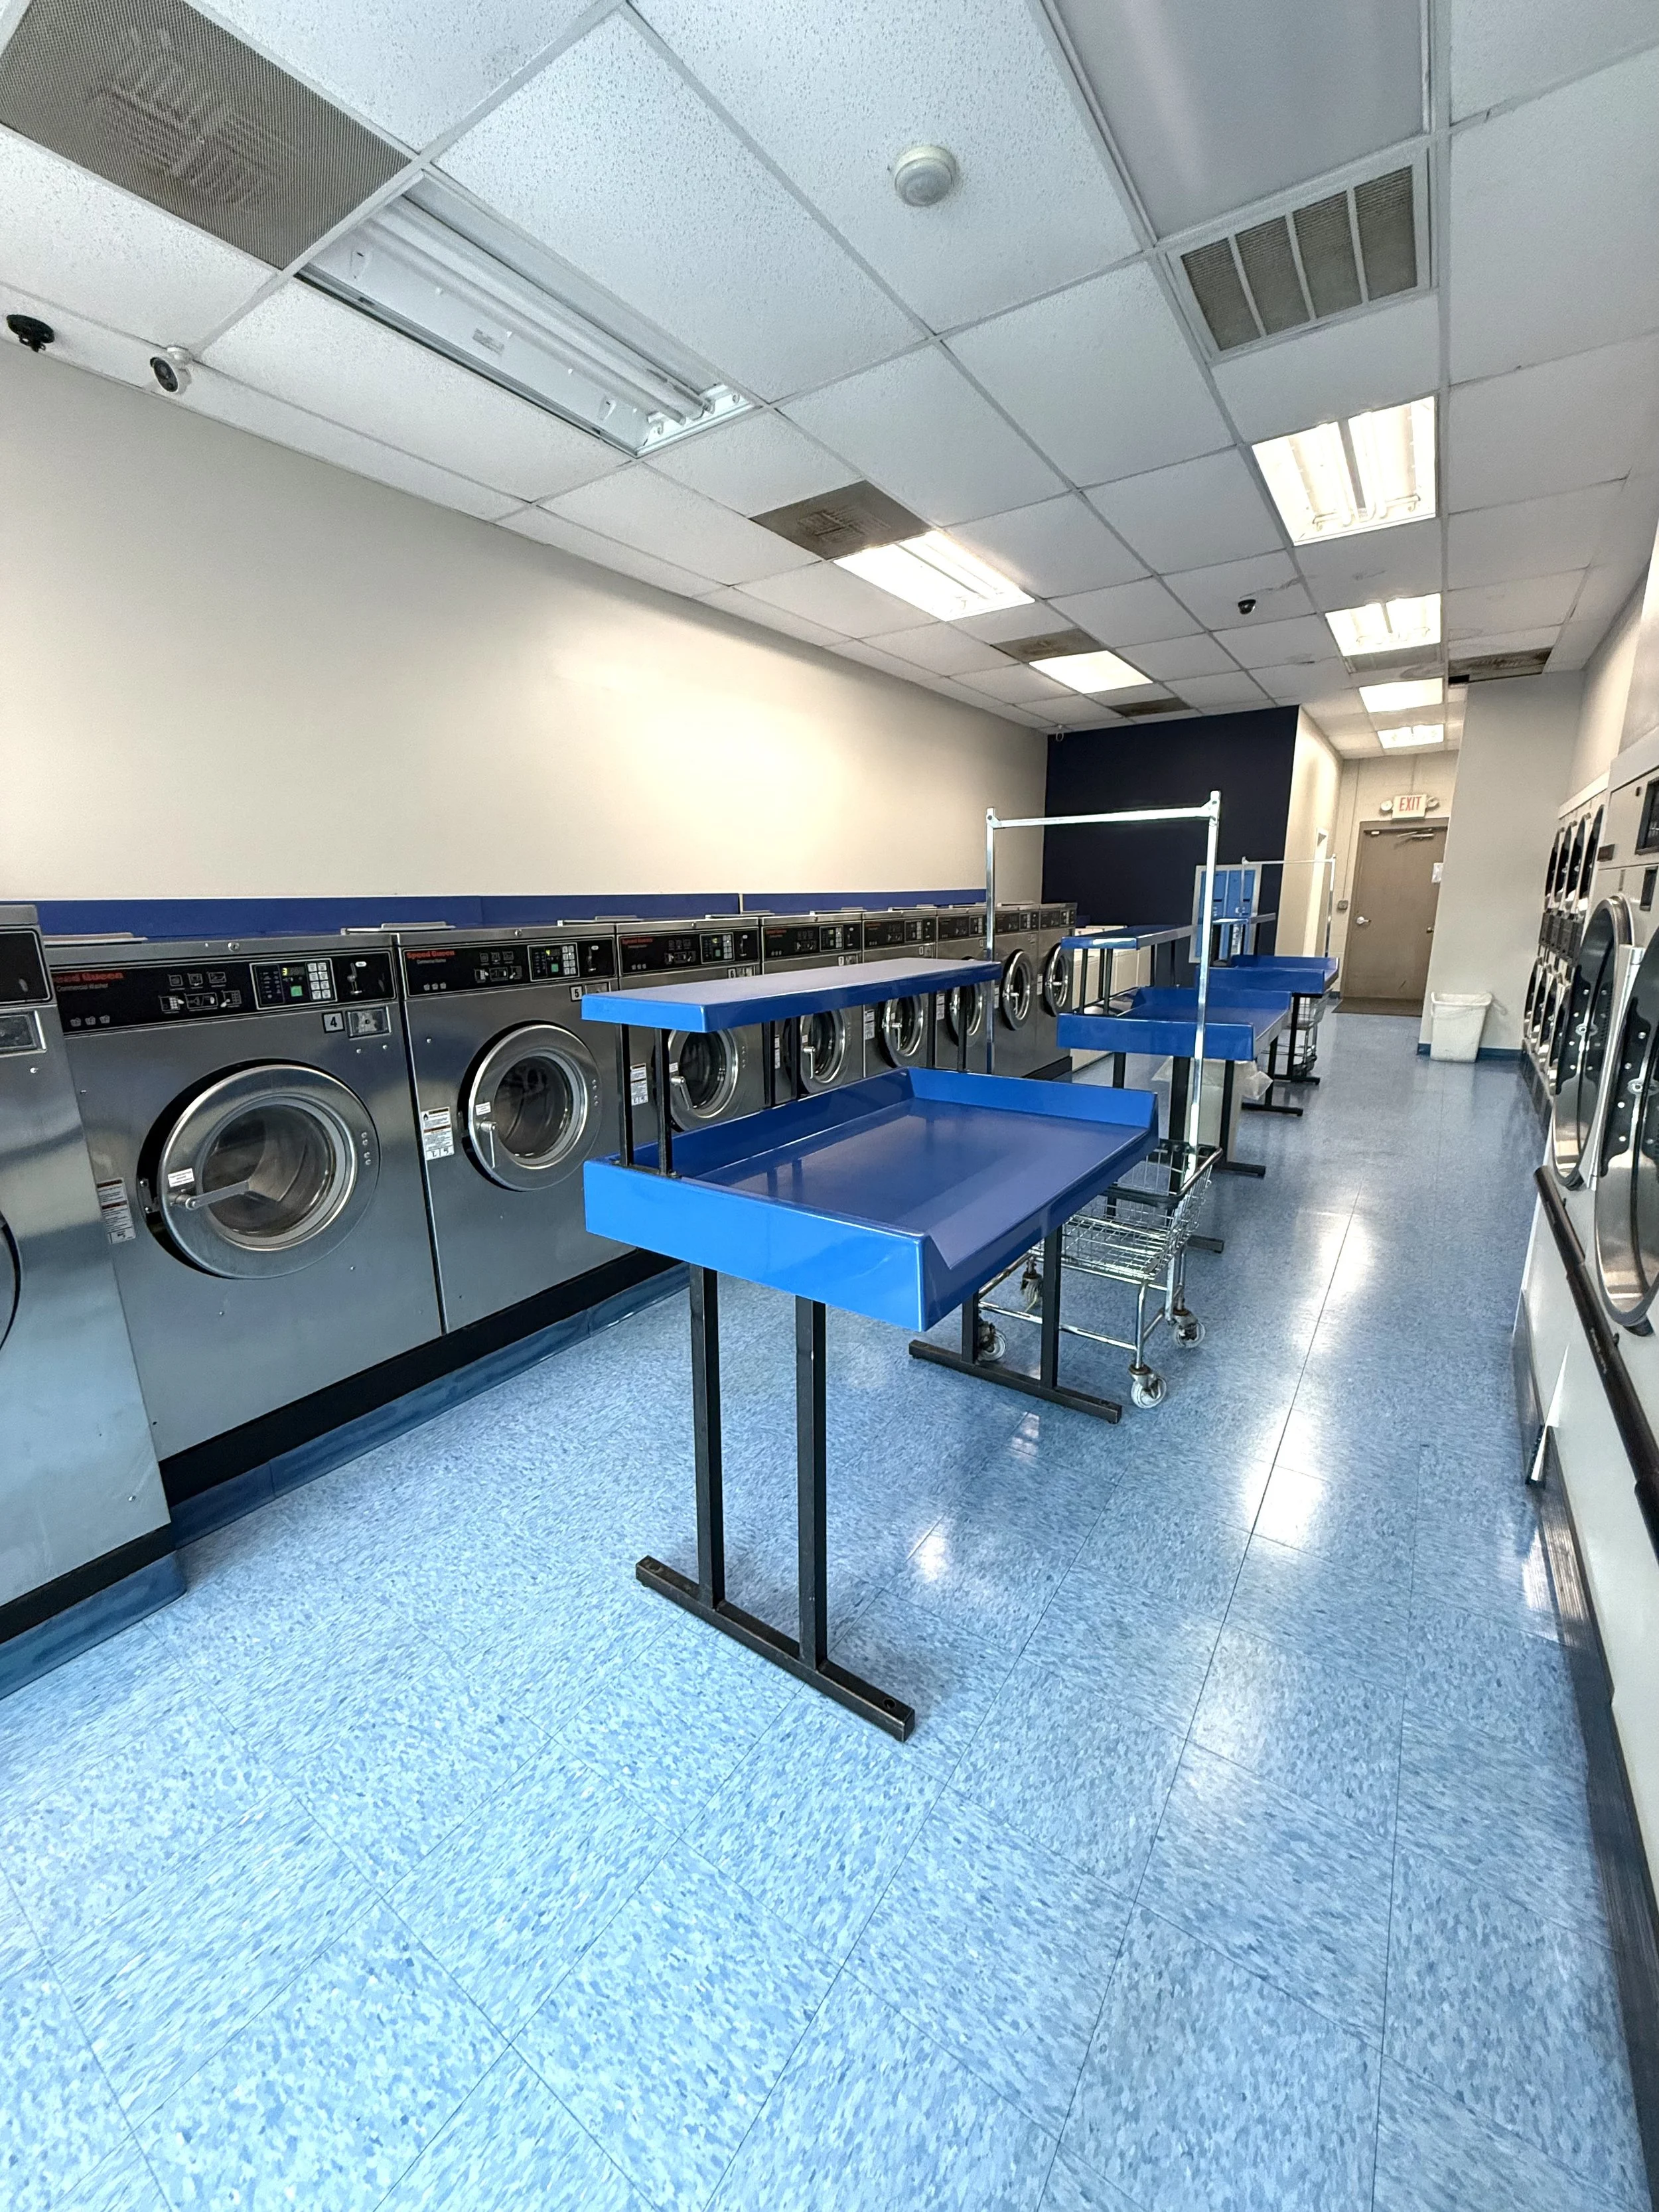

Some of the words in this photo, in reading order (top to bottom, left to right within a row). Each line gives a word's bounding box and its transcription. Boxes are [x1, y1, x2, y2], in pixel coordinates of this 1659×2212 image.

[1399, 796, 1421, 811] EXIT
[82, 972, 123, 981] Queen
[574, 989, 579, 997] 5
[330, 1016, 337, 1027] 4
